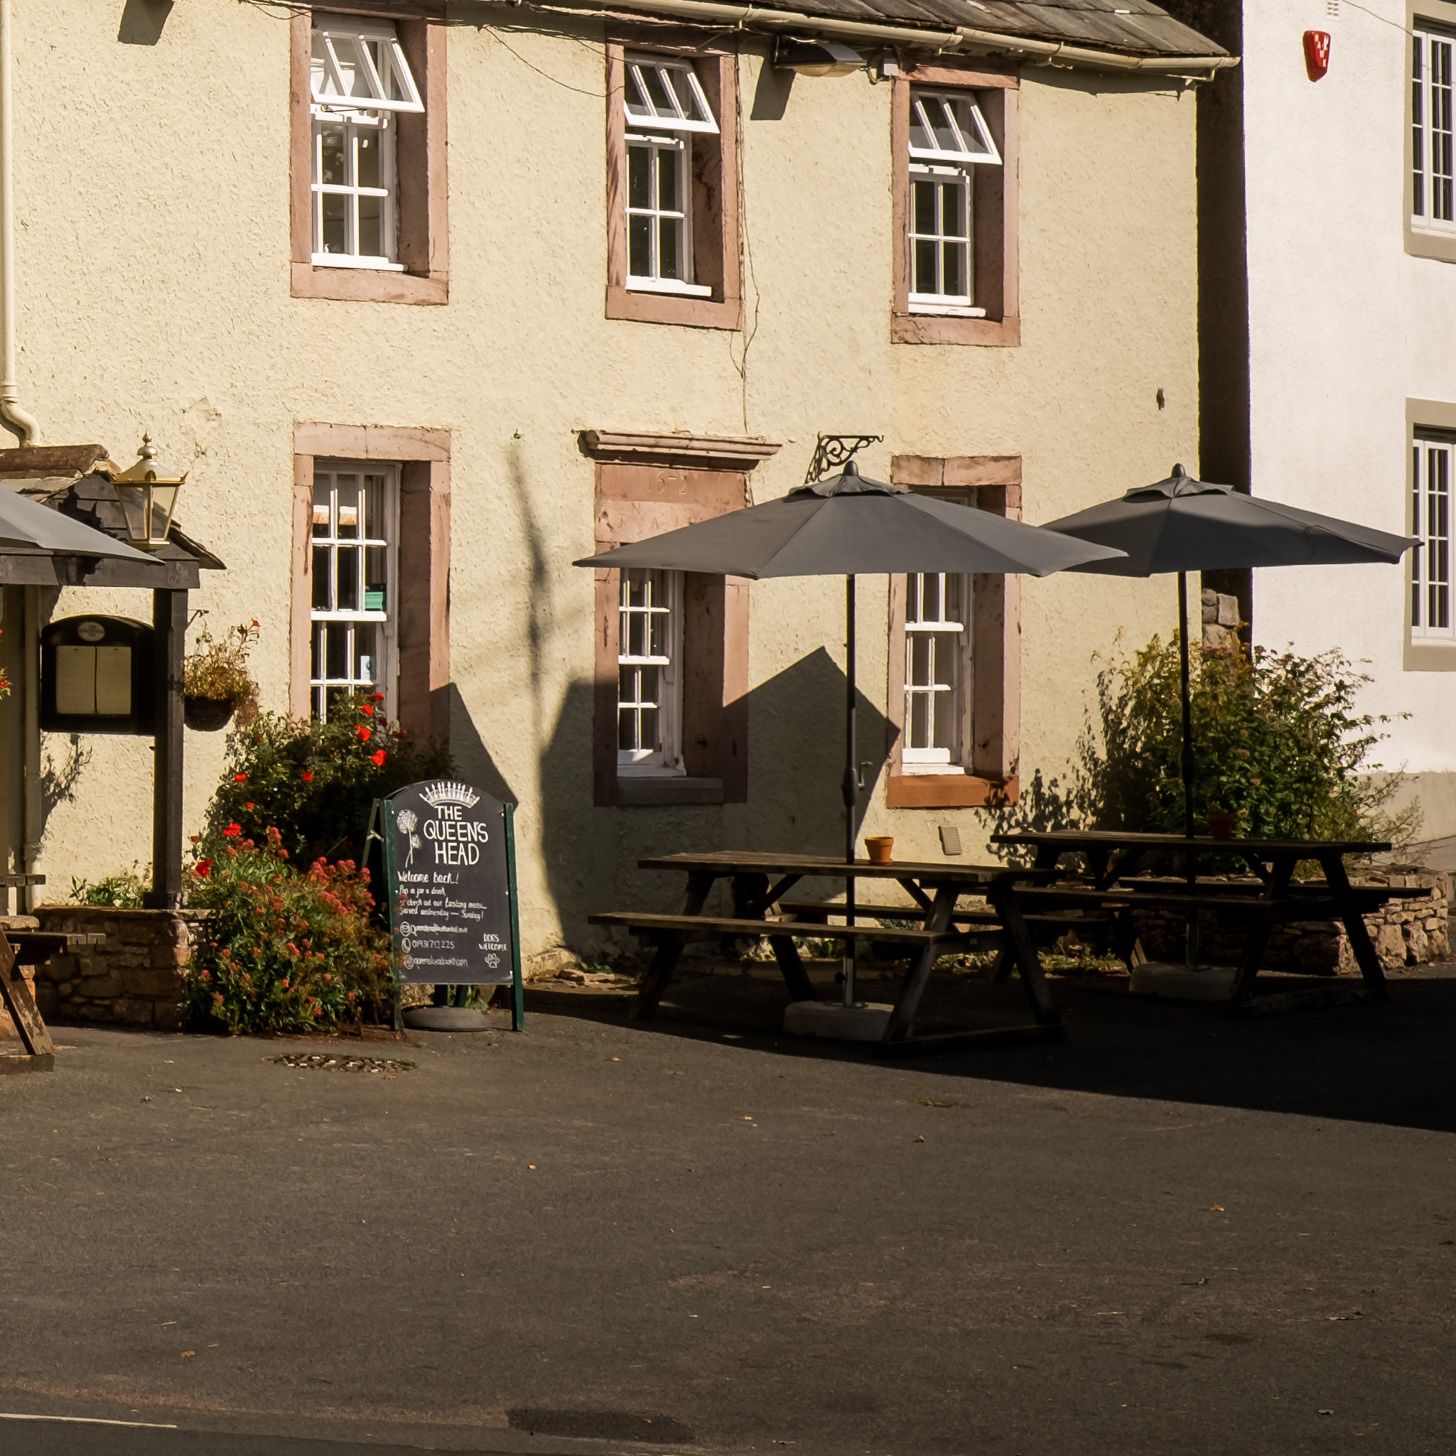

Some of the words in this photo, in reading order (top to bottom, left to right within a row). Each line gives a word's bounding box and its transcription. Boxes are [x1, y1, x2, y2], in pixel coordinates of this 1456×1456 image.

[434, 805, 463, 820] THE
[434, 841, 480, 866] HEAD
[397, 870, 429, 883] Welcome
